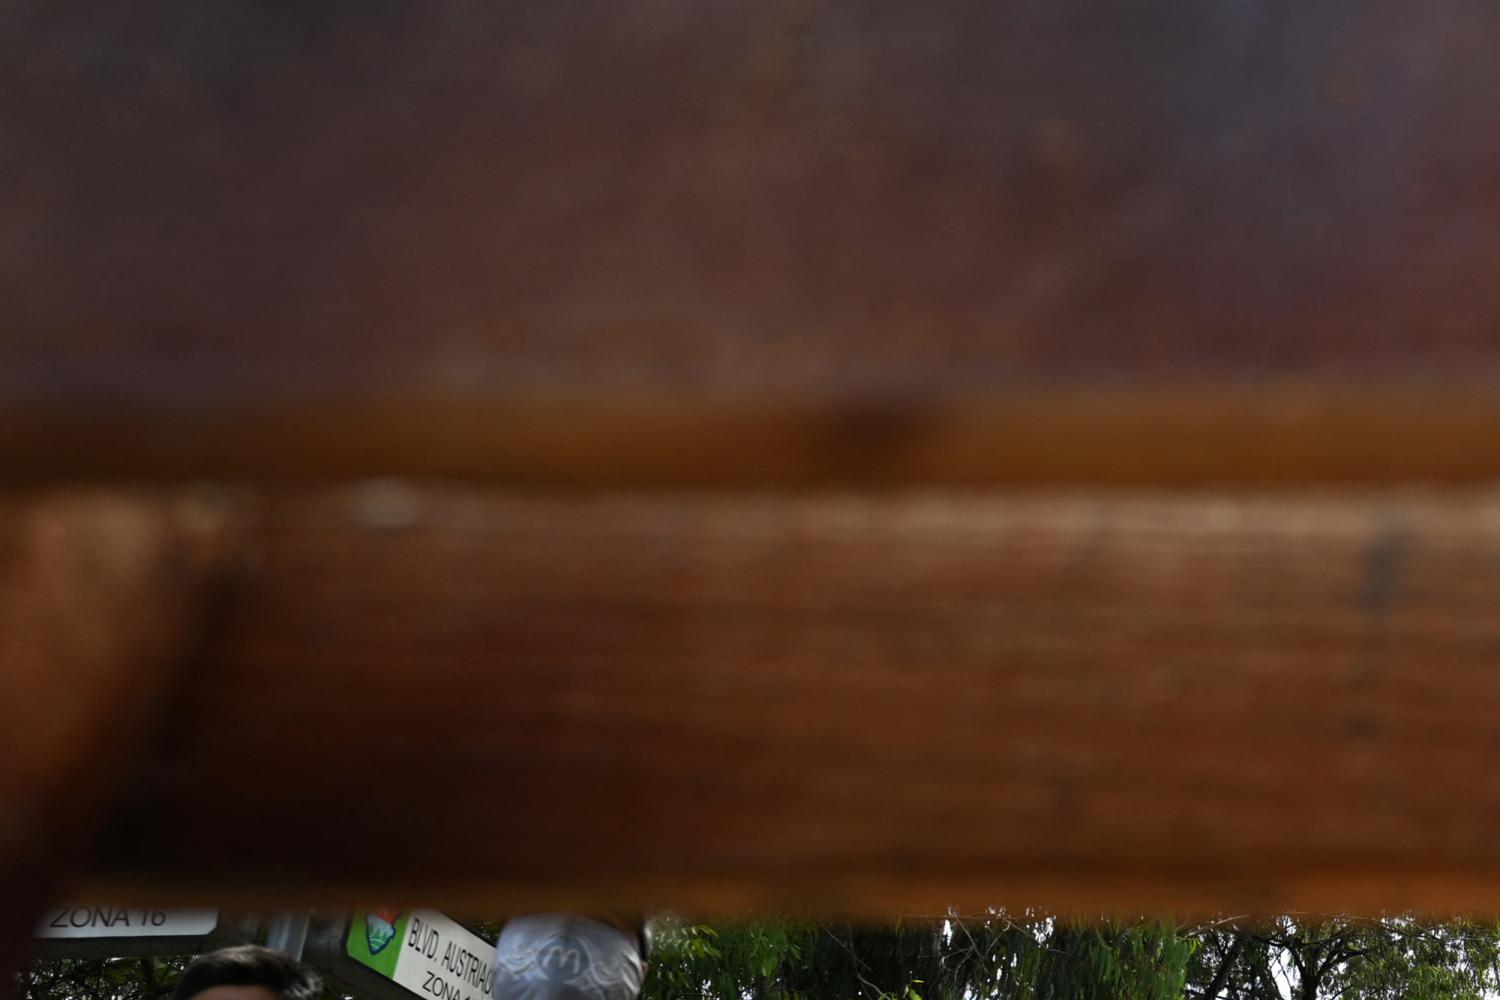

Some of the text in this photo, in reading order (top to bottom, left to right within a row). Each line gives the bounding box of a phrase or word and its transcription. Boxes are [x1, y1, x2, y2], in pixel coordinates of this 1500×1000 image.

[50, 905, 166, 928] ZONA 16
[408, 917, 494, 997] BLVD. AUSTRIAC
